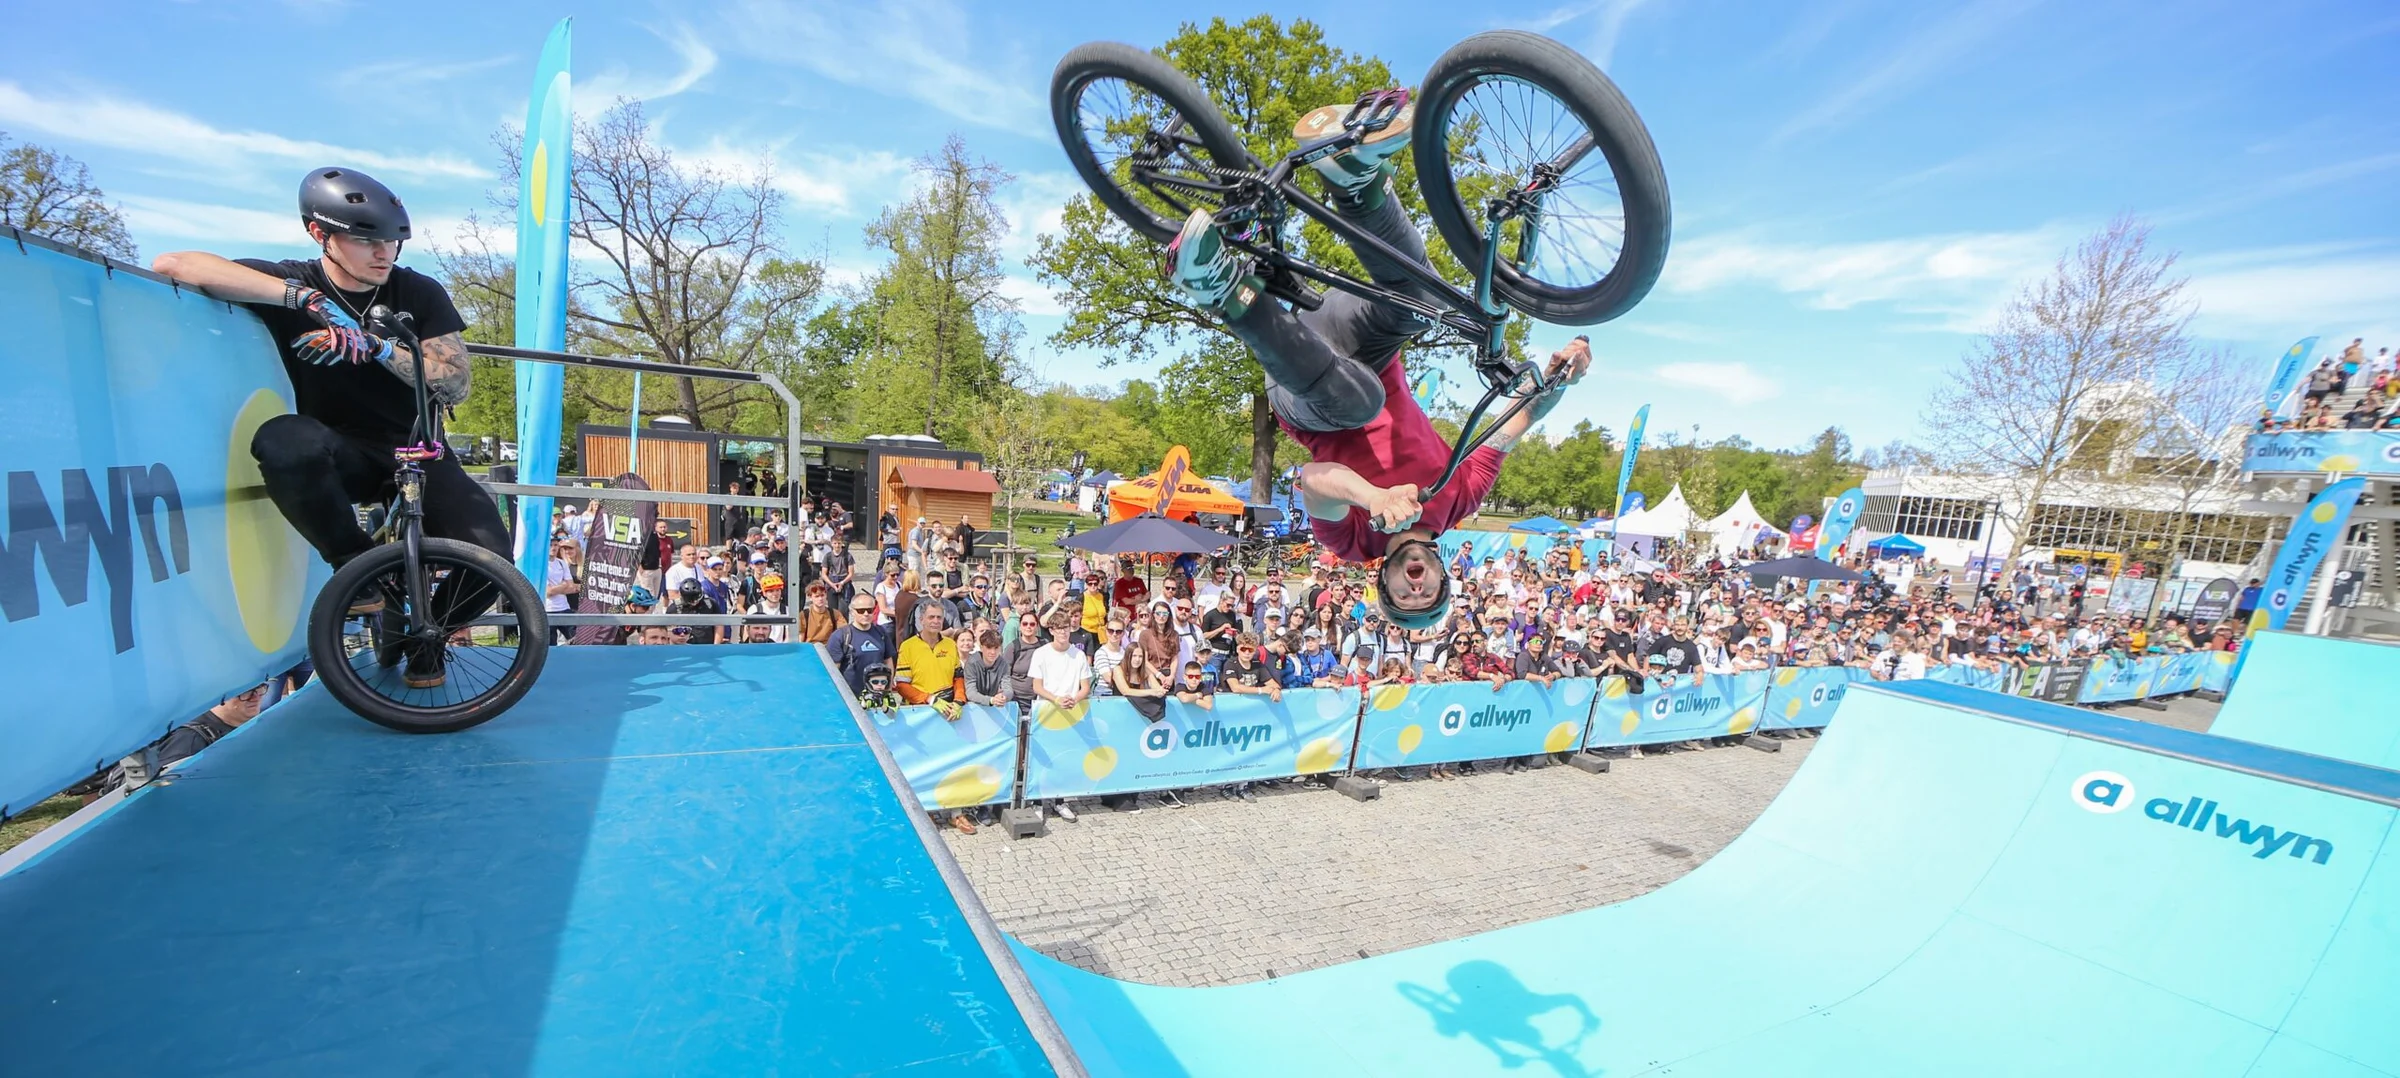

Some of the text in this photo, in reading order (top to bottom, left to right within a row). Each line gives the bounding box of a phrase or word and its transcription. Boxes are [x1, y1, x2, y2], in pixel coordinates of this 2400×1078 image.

[2257, 443, 2316, 460] allwyn
[1155, 455, 1187, 518] KTM
[602, 512, 642, 545] VSA
[2284, 532, 2322, 586] allwyn
[1655, 692, 1721, 717] a allwyn
[1813, 687, 1824, 701] a
[1444, 704, 1532, 732] a allwyn
[1146, 720, 1272, 752] a allwyn
[2083, 779, 2334, 865] a allwyn
